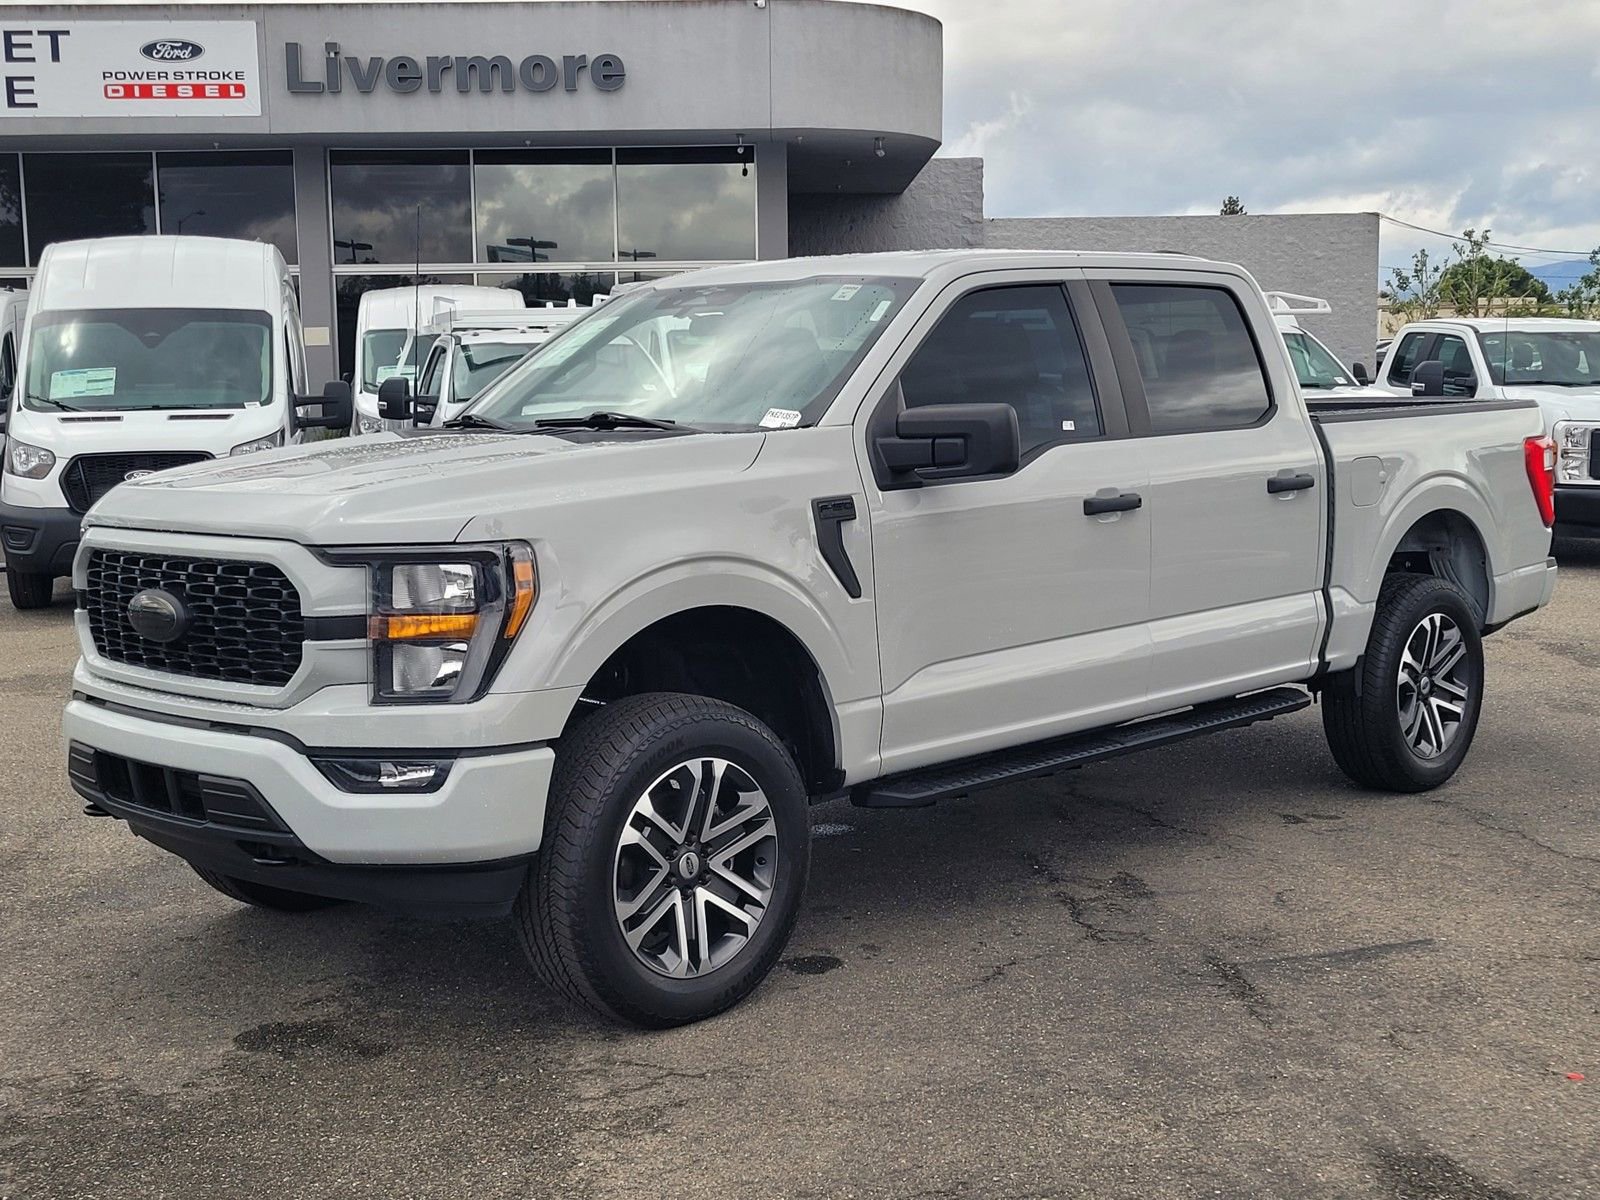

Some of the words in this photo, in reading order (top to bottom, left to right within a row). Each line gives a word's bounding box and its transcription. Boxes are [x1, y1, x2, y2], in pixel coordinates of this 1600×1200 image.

[152, 42, 193, 60] Ford
[285, 42, 626, 93] Livermore
[103, 71, 169, 81] POWER
[173, 71, 245, 80] STROKE
[107, 85, 244, 97] DIESEL
